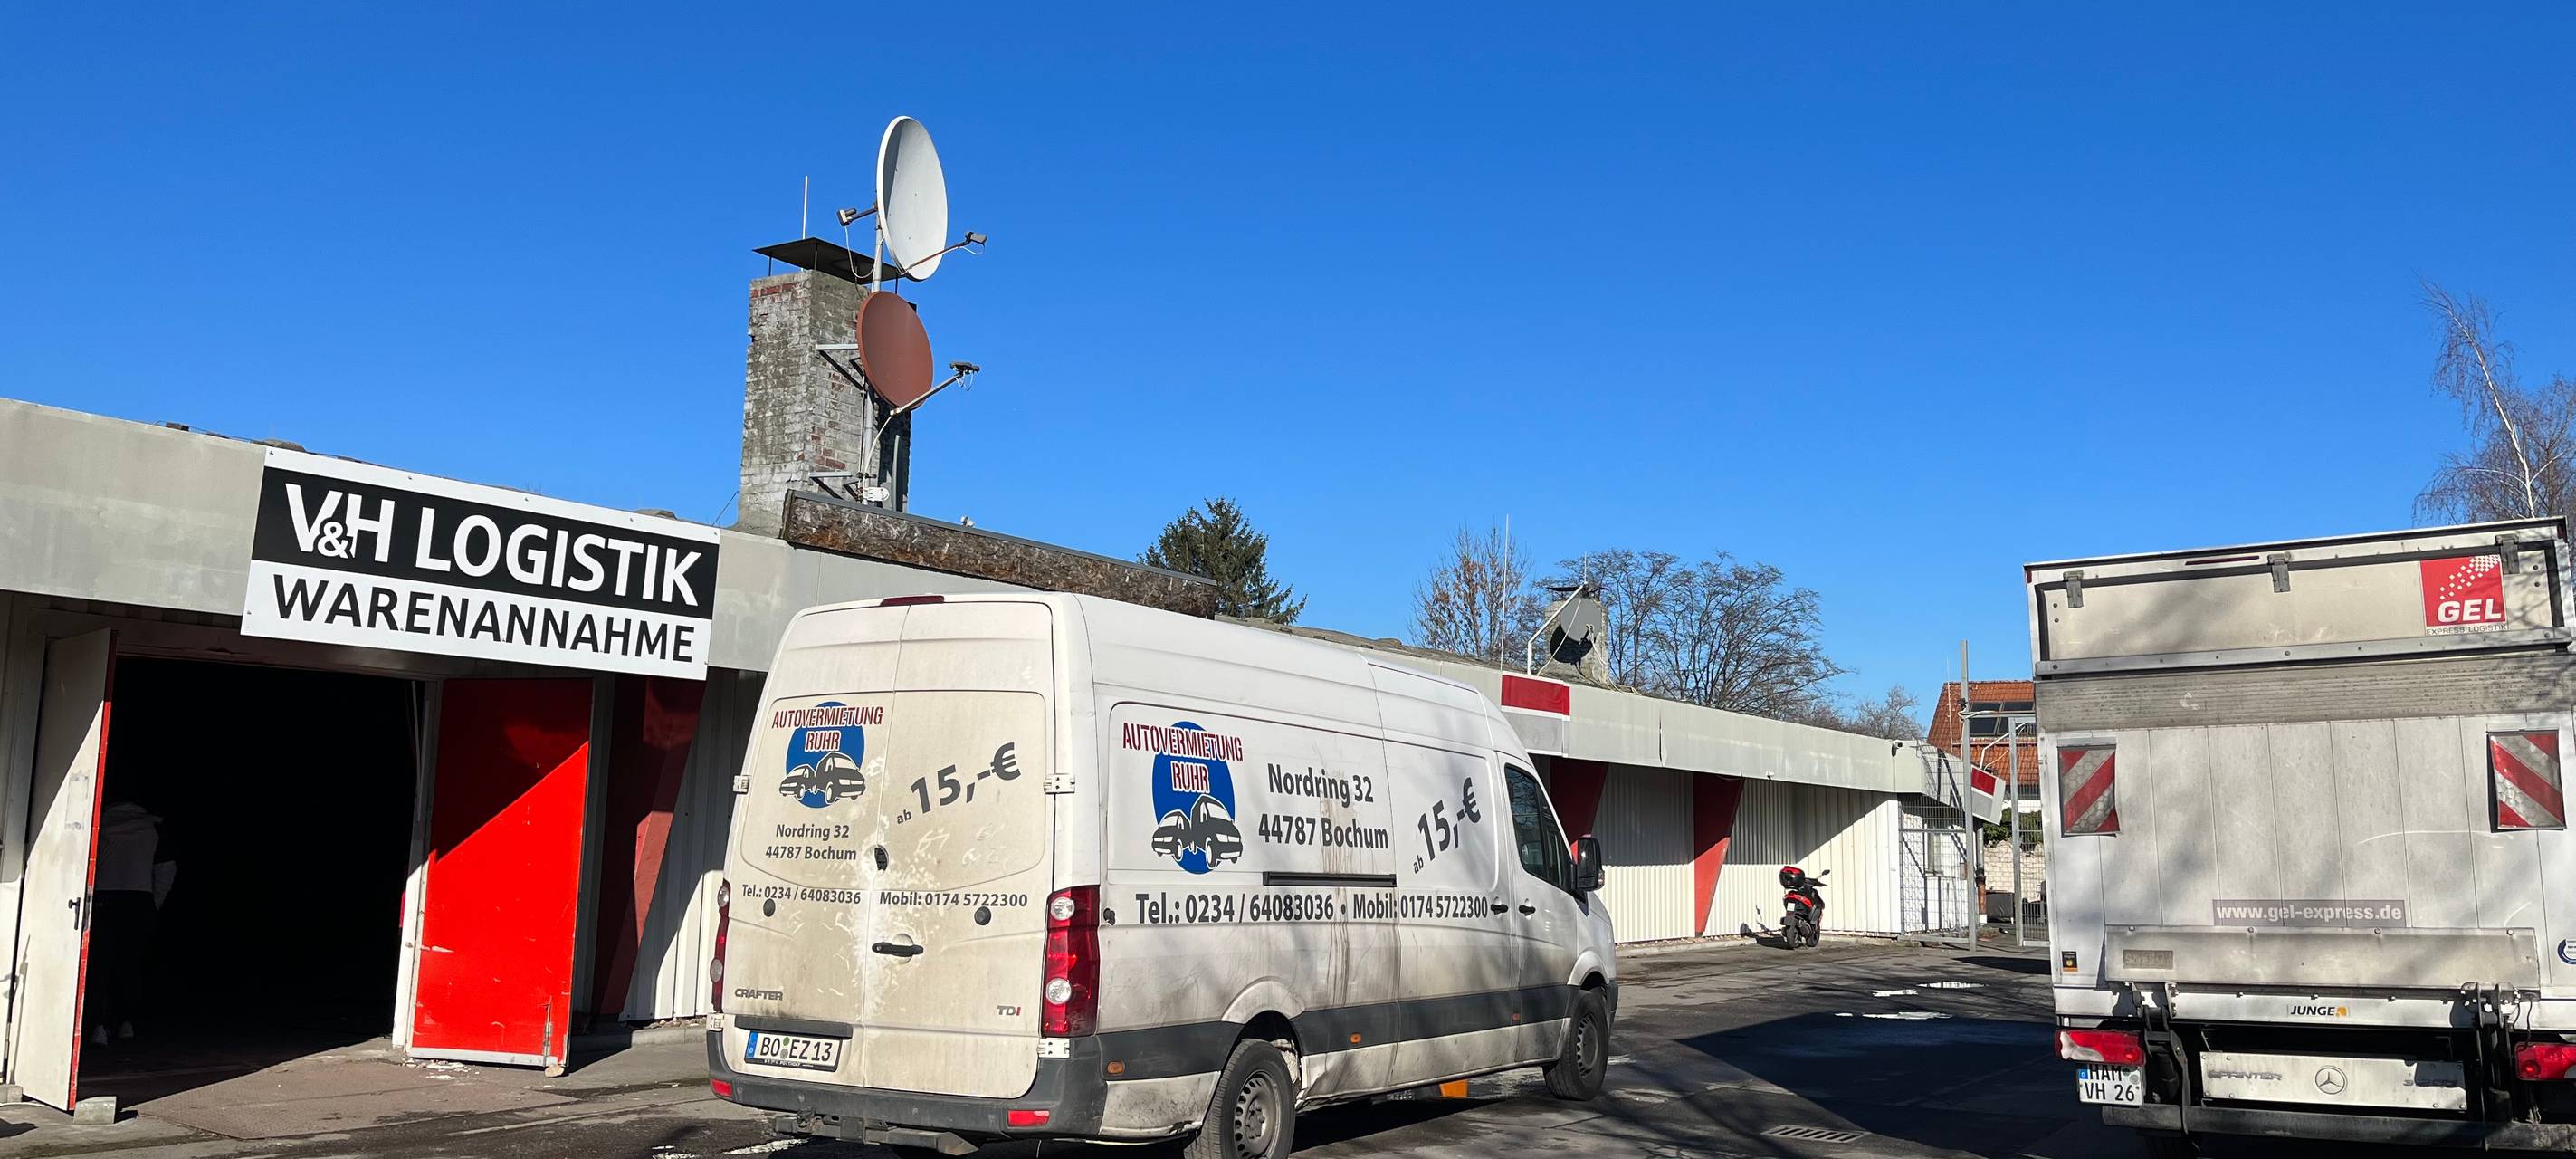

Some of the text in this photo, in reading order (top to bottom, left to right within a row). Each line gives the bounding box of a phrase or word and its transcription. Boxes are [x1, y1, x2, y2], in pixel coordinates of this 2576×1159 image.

[285, 483, 702, 607] V&H LOGISTIK
[273, 573, 695, 663] WARENANNAHME
[2438, 598, 2502, 623] GEL
[771, 706, 883, 729] AUTOVERMIETUNG
[806, 732, 840, 751] RUHR
[1122, 723, 1244, 761] AUTOVERMIETUNG
[1172, 762, 1208, 792] RUHR
[1268, 763, 1374, 808] Nordring 32
[896, 809, 911, 824] ab
[776, 824, 850, 841] Nordring 32
[1258, 813, 1388, 849] 44787 Bochum
[765, 846, 857, 860] 44787 Bochum
[1413, 854, 1424, 874] ab
[742, 884, 762, 897] Tel.:
[764, 886, 791, 900] 0234
[800, 888, 861, 904] 64083036
[879, 891, 1028, 907] Mobil: 0174 5722300
[1135, 892, 1180, 924] Tel.:
[1186, 894, 1235, 923] 0234
[1249, 894, 1334, 921] 64083036
[1353, 893, 1488, 919] Mobil: 0174 5722300
[2216, 904, 2403, 924] www.gel-express.de
[735, 988, 783, 1001] CRAFTER
[997, 1005, 1021, 1016] TDI
[2290, 1005, 2335, 1016] JUNGE
[760, 1037, 780, 1057] BO
[789, 1039, 811, 1060] EZ
[811, 1042, 833, 1061] 13
[2085, 1081, 2135, 1102] VH 26
